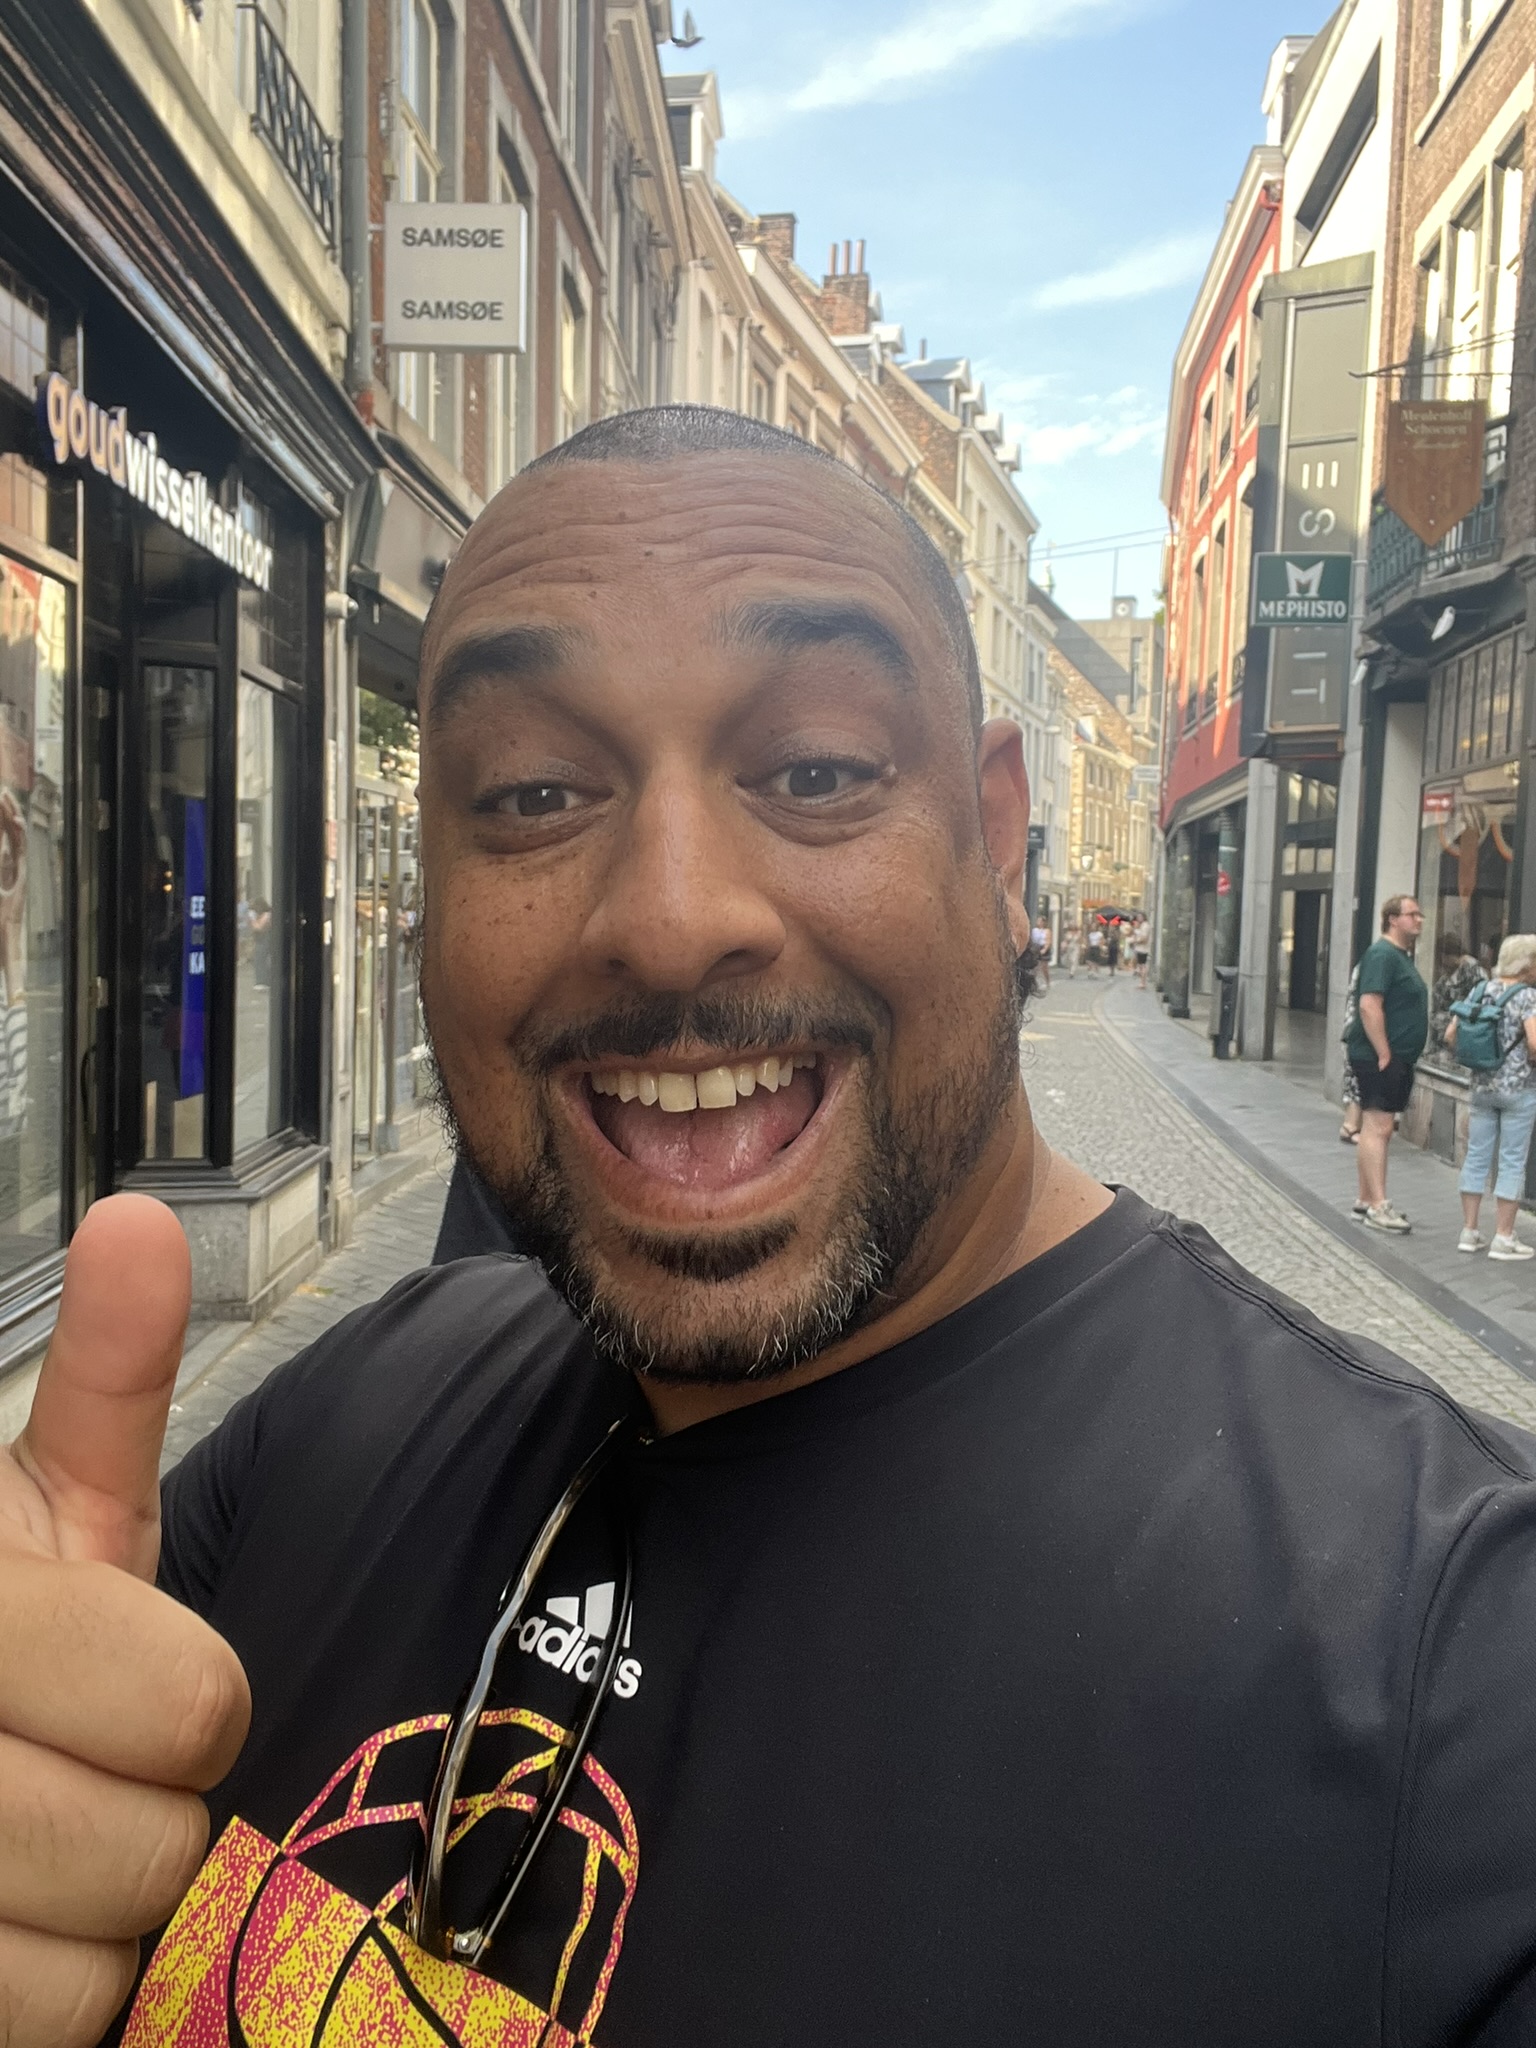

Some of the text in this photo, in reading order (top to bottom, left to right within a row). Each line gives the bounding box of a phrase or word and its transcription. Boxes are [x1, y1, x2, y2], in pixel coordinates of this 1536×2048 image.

[402, 227, 504, 248] SAMSØE
[401, 300, 504, 320] SAMSØE
[46, 371, 273, 593] goudwisselkantoor
[1259, 600, 1347, 618] MEPHISTO
